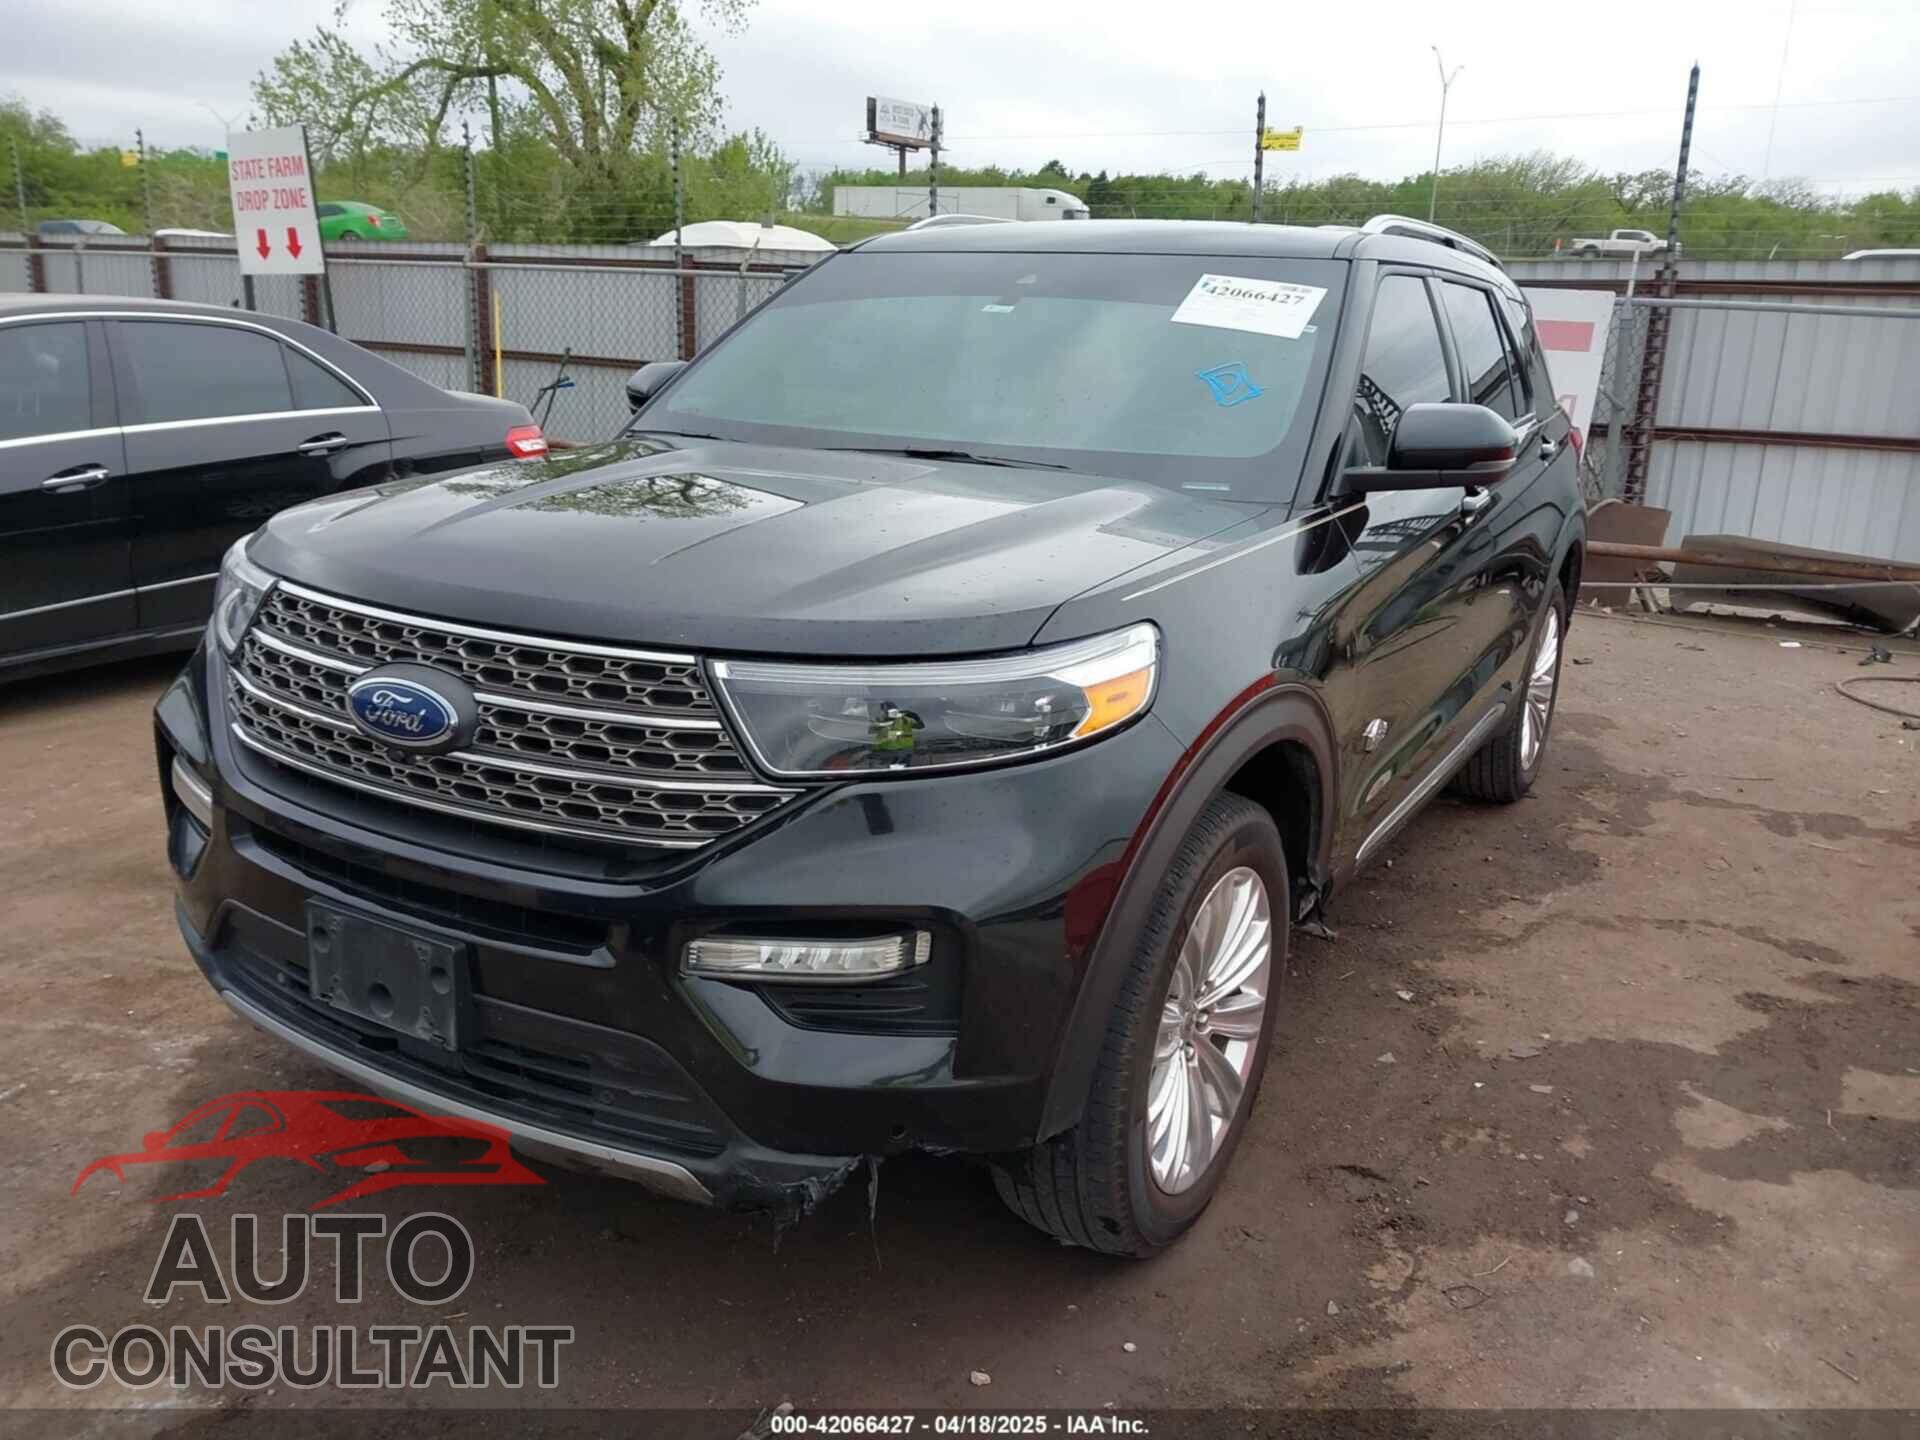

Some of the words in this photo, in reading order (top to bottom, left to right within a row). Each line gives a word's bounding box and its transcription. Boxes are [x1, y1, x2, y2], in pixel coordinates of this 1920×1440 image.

[232, 157, 265, 181] STATE
[268, 155, 305, 178] FARM
[236, 190, 269, 211] DROP
[272, 187, 308, 209] ZONE
[1205, 286, 1305, 304] 42066427
[365, 690, 427, 733] Ford
